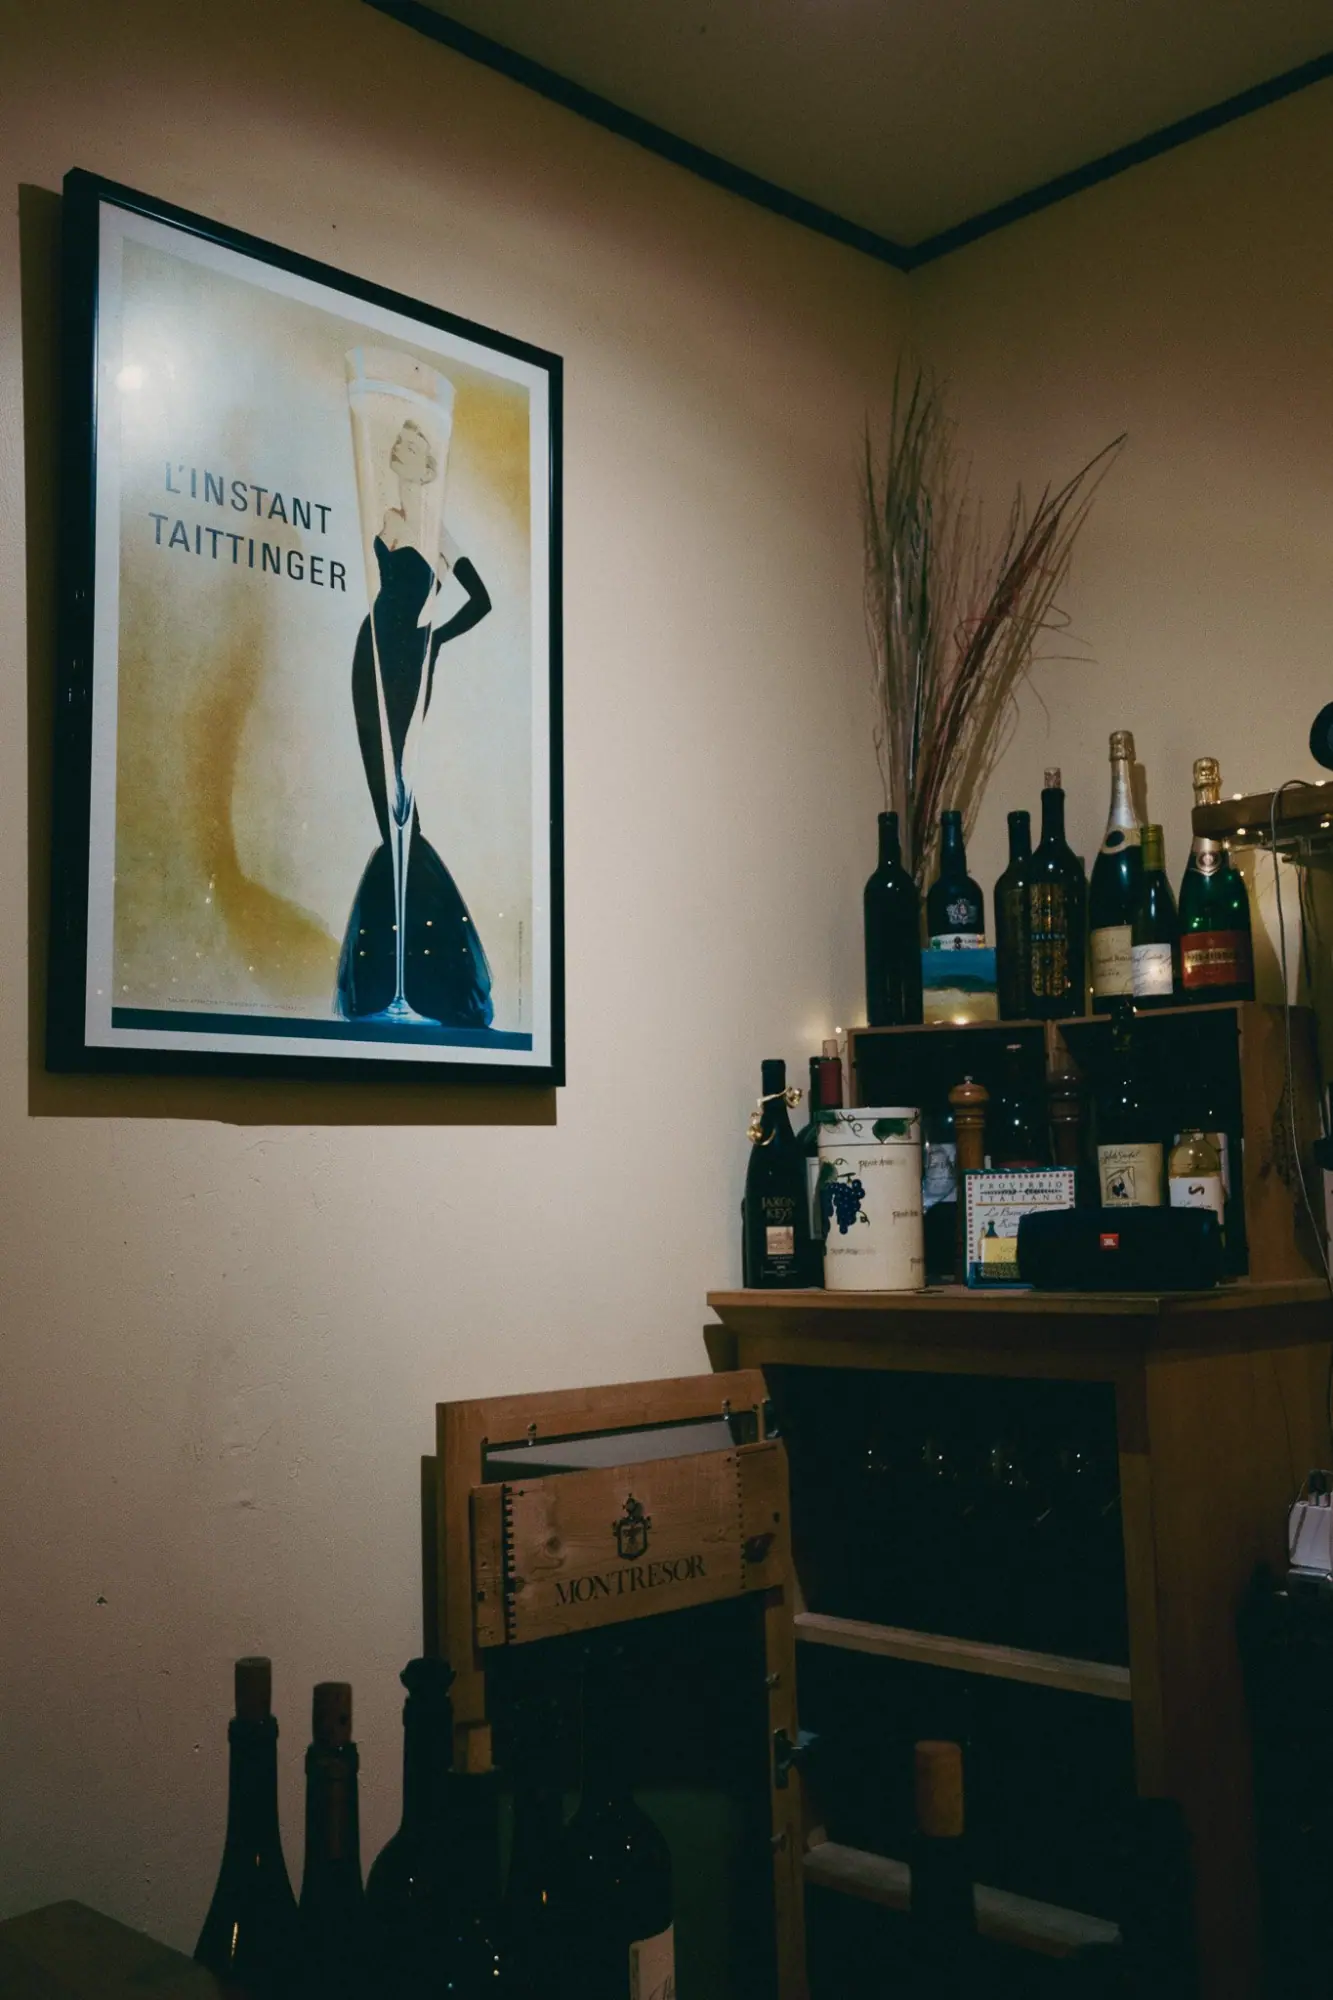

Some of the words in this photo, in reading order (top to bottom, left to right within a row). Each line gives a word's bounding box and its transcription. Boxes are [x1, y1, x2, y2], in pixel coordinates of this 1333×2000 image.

[165, 461, 332, 534] L'INSTANT
[148, 512, 347, 593] TAITTINGER
[979, 1181, 1063, 1189] PROVERBIO
[979, 1194, 1063, 1202] ITALIANO
[555, 1555, 706, 1606] MONTRESOR
